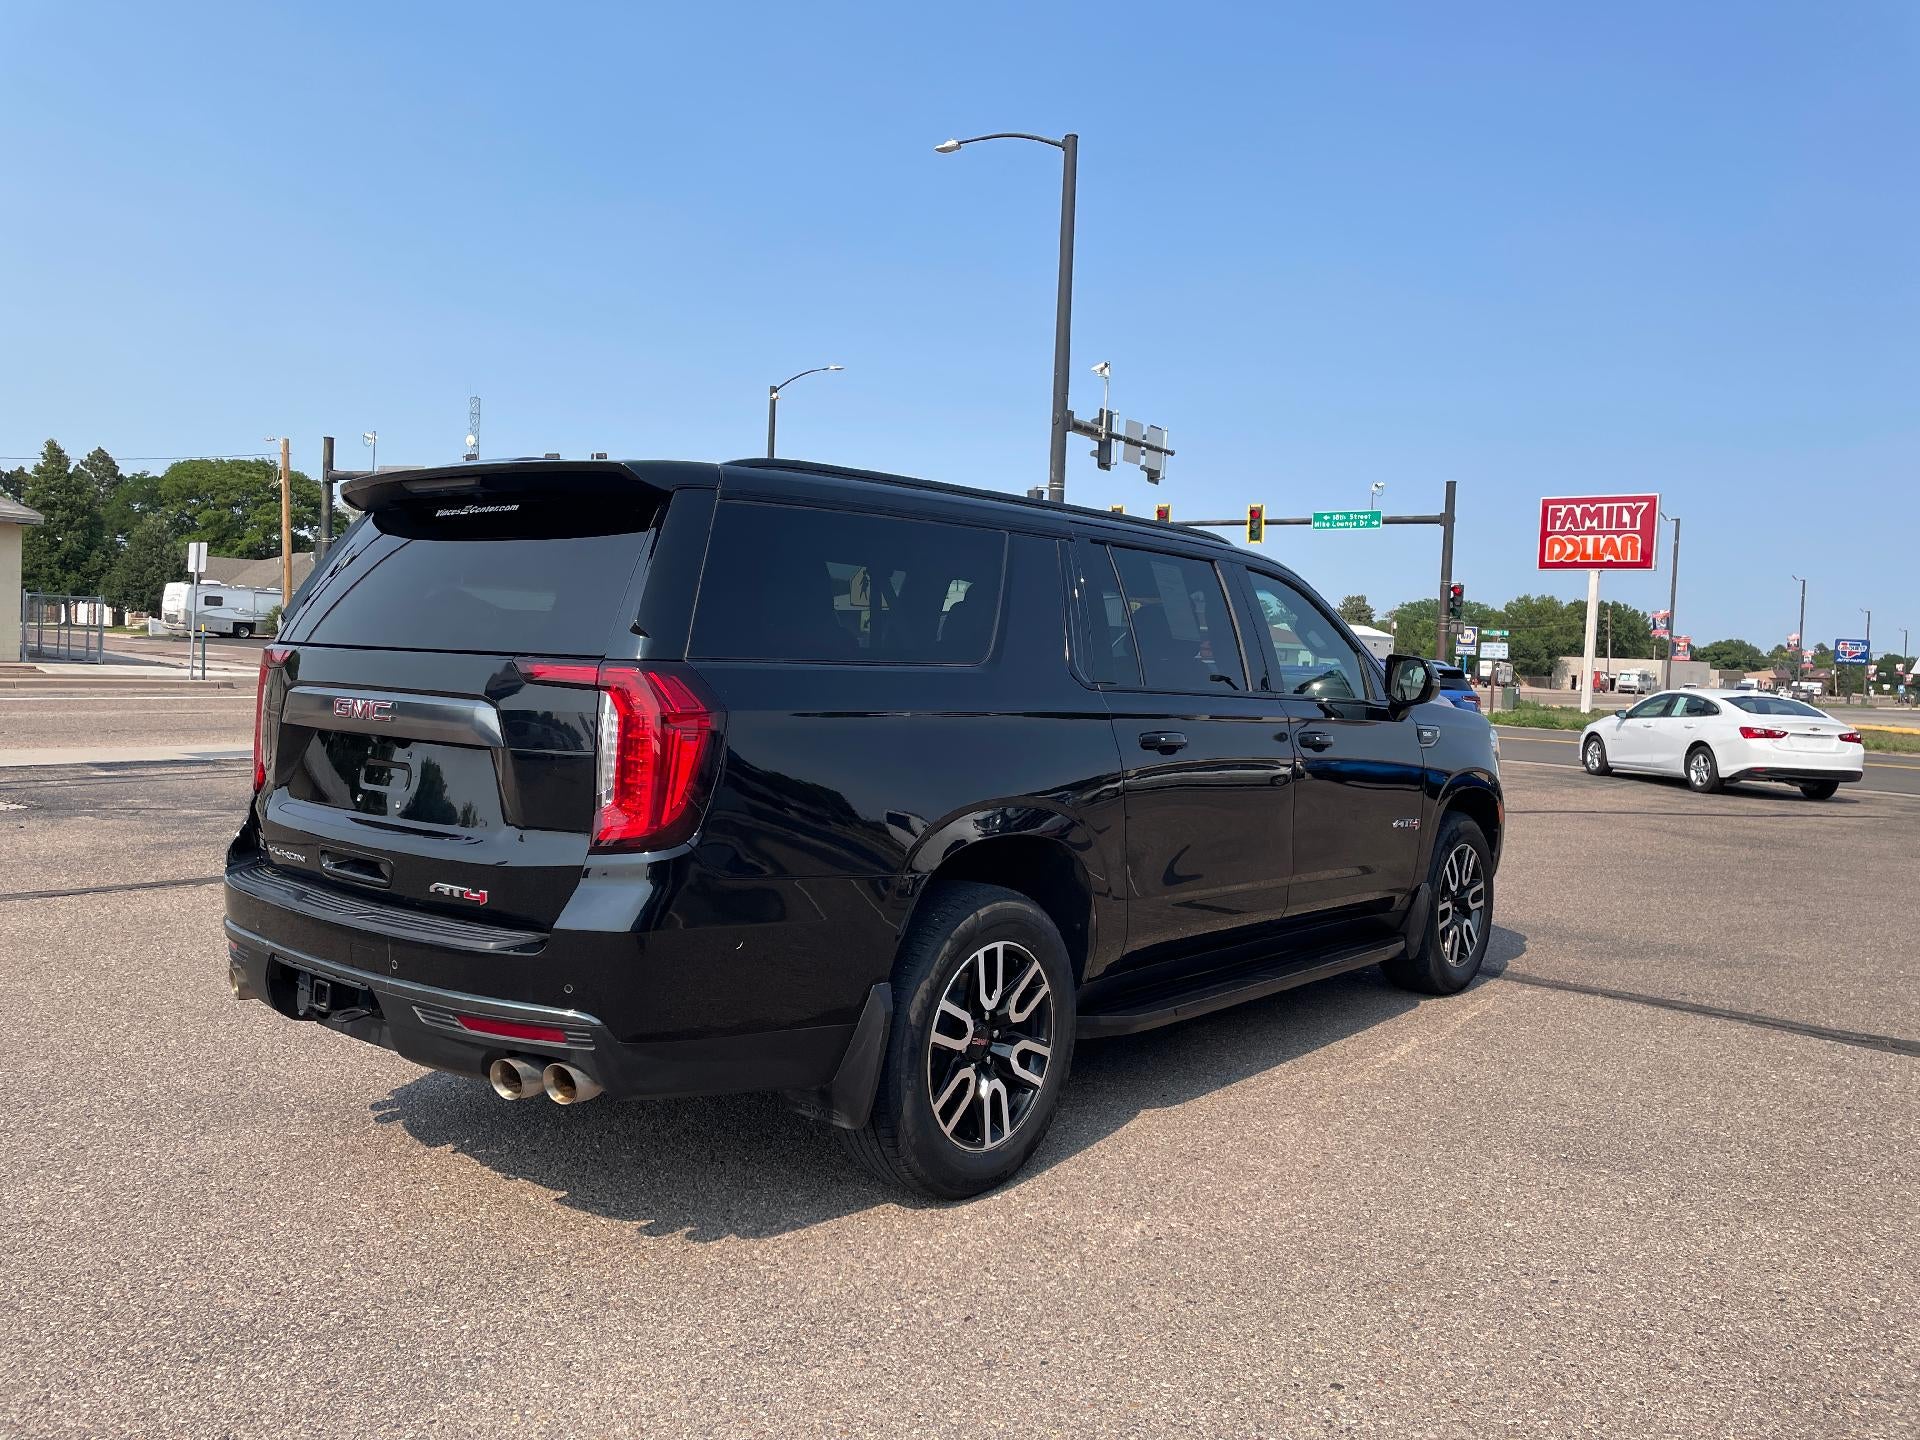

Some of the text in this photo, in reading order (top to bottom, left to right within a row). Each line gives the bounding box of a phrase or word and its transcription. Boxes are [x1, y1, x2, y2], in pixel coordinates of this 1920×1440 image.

[1332, 520, 1357, 528] Lounge
[1547, 502, 1649, 531] FAMILY
[1545, 534, 1642, 562] DOLLAR
[333, 697, 392, 721] GMC
[429, 882, 488, 905] AT4
